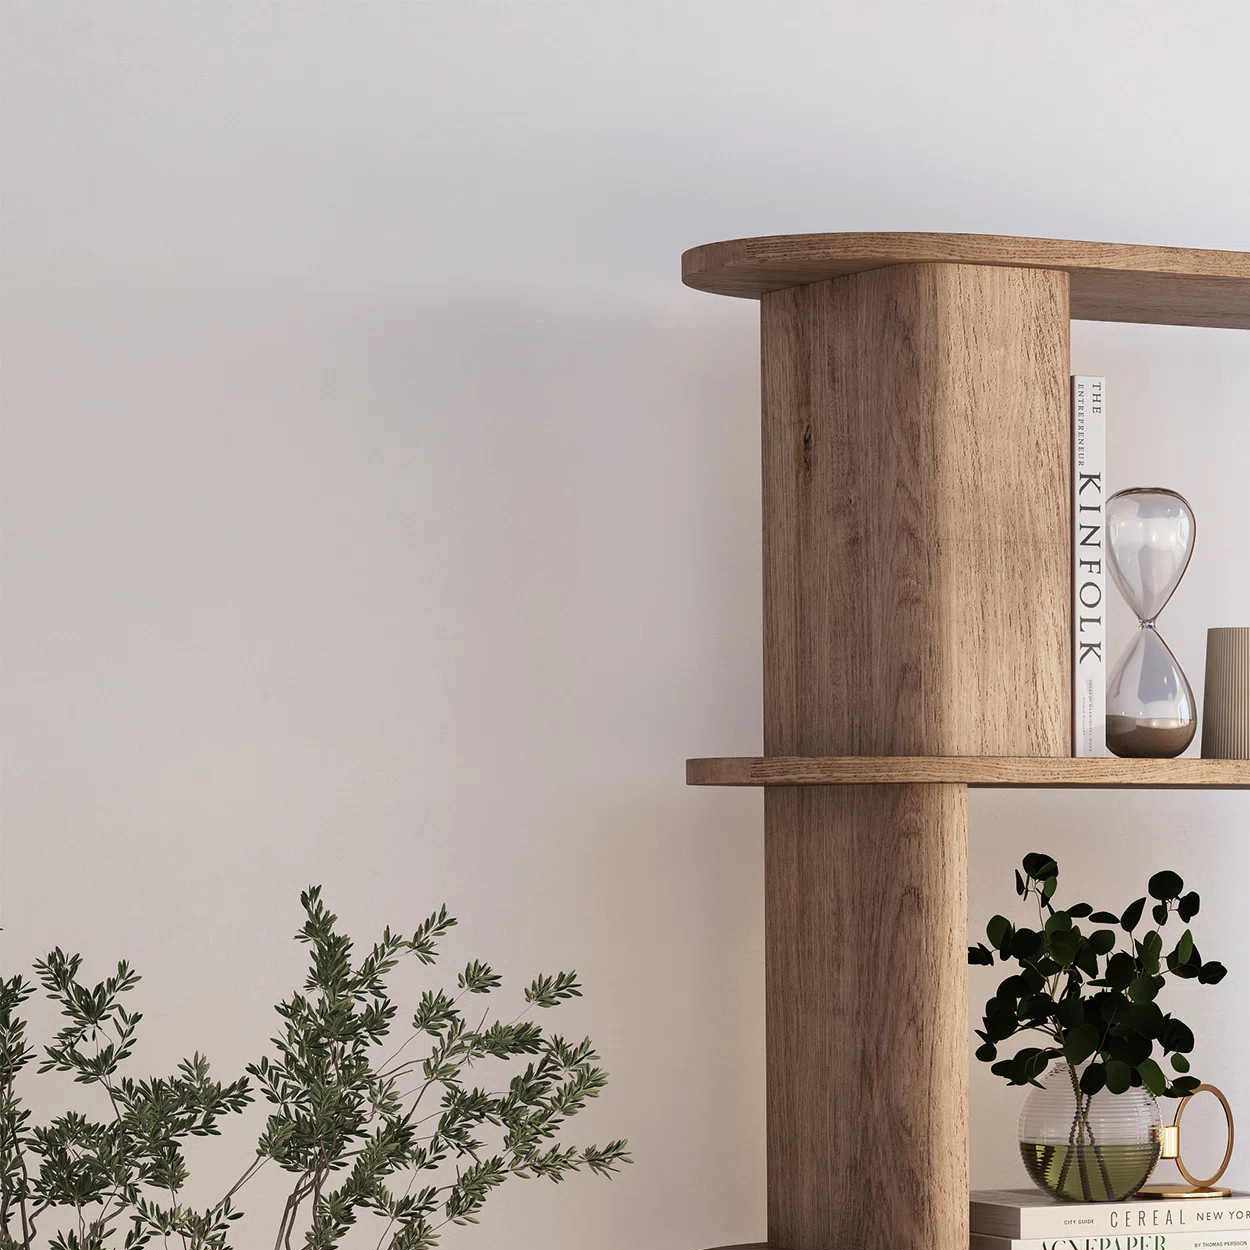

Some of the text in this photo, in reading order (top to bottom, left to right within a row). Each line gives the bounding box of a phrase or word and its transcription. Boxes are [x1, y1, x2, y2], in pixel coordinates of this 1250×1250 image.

[1092, 382, 1102, 414] THE
[1079, 471, 1102, 664] KINFOLK
[1110, 1209, 1186, 1228] CEREAL
[1196, 1211, 1224, 1221] NEW
